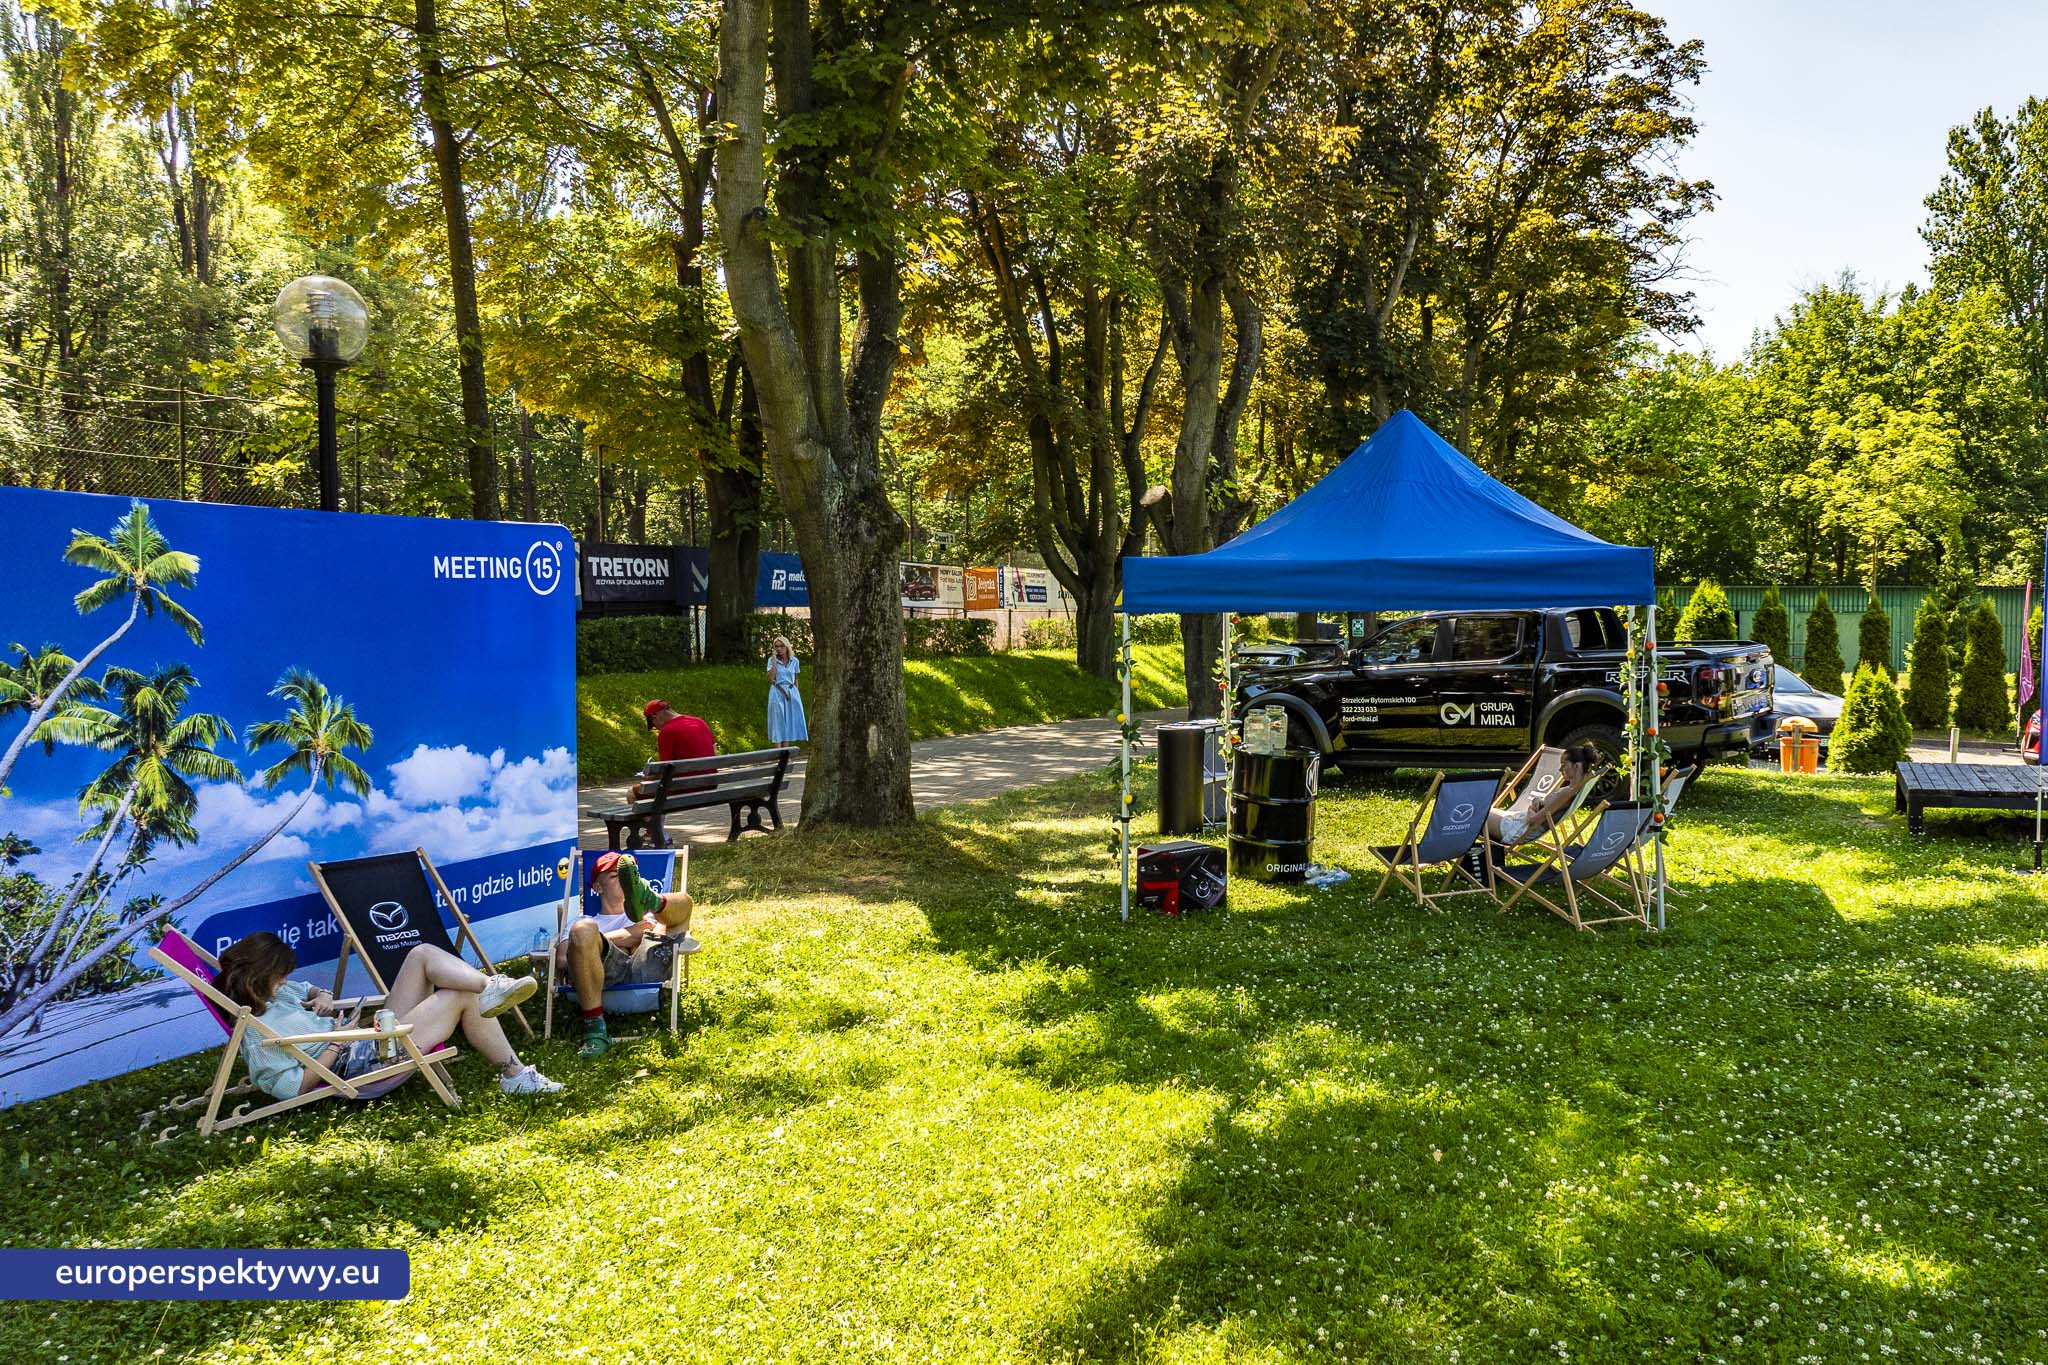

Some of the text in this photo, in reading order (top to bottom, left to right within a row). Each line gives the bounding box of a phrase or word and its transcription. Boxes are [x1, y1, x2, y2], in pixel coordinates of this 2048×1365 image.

[433, 555, 553, 579] MEETING 15
[587, 556, 670, 578] TRETORN
[1370, 697, 1404, 705] Bytomskich
[1405, 696, 1417, 704] 100
[1480, 702, 1515, 712] GRUPA
[1342, 715, 1379, 723] ford-mirai.pl
[1480, 713, 1516, 726] MIRAI
[306, 913, 339, 940] tak
[472, 873, 515, 904] gdzie
[518, 864, 554, 887] lubię
[376, 929, 421, 943] mazda
